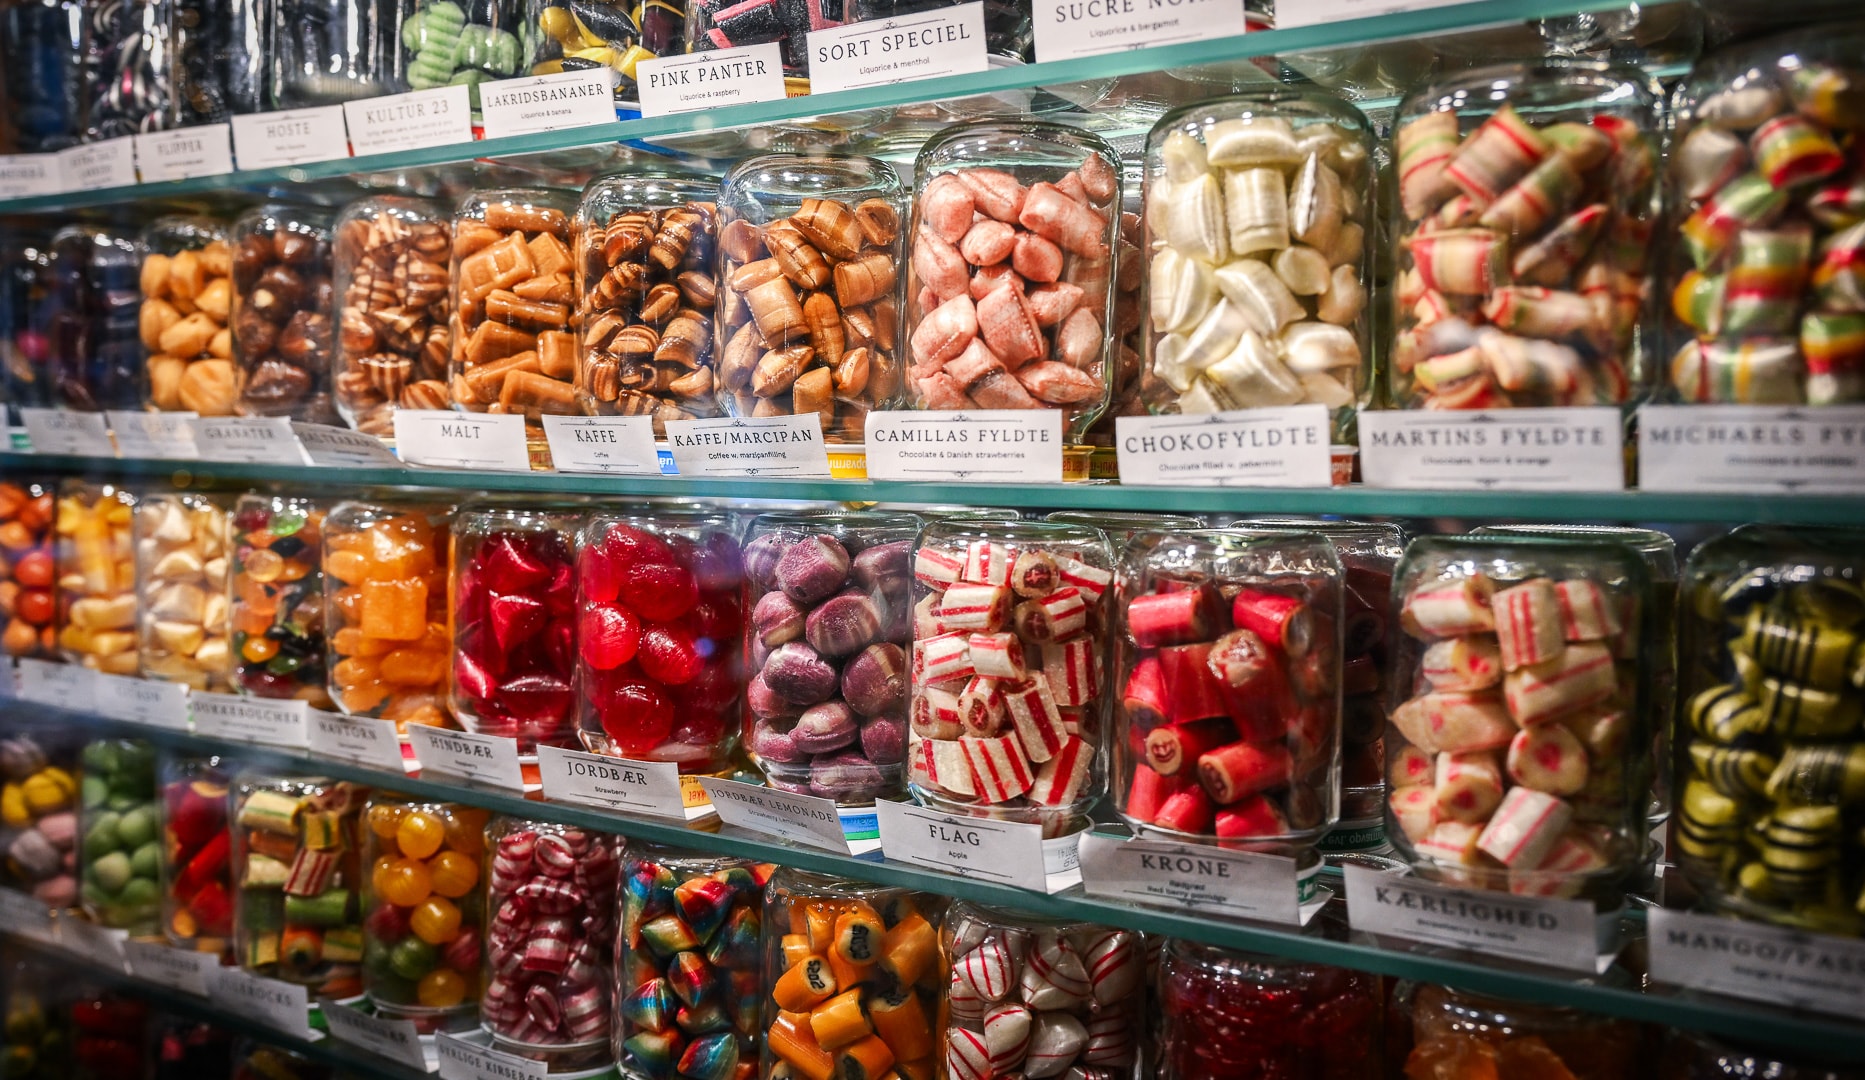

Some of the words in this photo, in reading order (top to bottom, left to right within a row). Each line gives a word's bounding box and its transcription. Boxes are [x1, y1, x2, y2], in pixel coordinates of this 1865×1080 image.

[1055, 0, 1134, 23] SUCRE
[819, 39, 871, 63] SORT
[882, 23, 971, 52] SPECIEL
[649, 70, 691, 88] PINK
[698, 59, 768, 81] PANTER
[859, 62, 892, 75] Liquorice
[900, 56, 930, 68] menthol
[487, 83, 604, 108] LAKRIDSBANANER
[679, 91, 706, 101] Liquorice
[712, 87, 741, 99] raspberry
[366, 102, 427, 124] KULTUR
[431, 99, 449, 115] 23
[520, 111, 544, 120] Liquorice
[551, 108, 572, 117] banana
[441, 424, 481, 440] MALT
[574, 429, 617, 444] KAFFE
[674, 428, 813, 447] KAFFE/MARCIPAN
[874, 429, 969, 443] CAMILLAS
[978, 429, 1050, 443] FYLDTE
[1125, 426, 1320, 454] CHOKOFYLDTE
[1371, 429, 1488, 448] MARTINS
[1501, 427, 1606, 447] FYLDTE
[1650, 426, 1806, 446] MICHAELS
[708, 452, 730, 460] Coffee
[898, 450, 938, 459] Chocolate
[939, 450, 945, 458] &
[946, 450, 973, 459] Danish
[975, 451, 1025, 459] strawberries
[429, 736, 494, 760] HINDBÆR
[567, 761, 648, 786] JORDBÆR
[594, 785, 627, 798] Strawberry
[710, 788, 765, 807] JORDBÆR
[769, 800, 834, 823] LEMONADE
[928, 824, 981, 847] FLAG
[948, 850, 968, 861] Apple
[1140, 854, 1232, 878] KRONE
[1375, 887, 1559, 932] KÆRLIGHED
